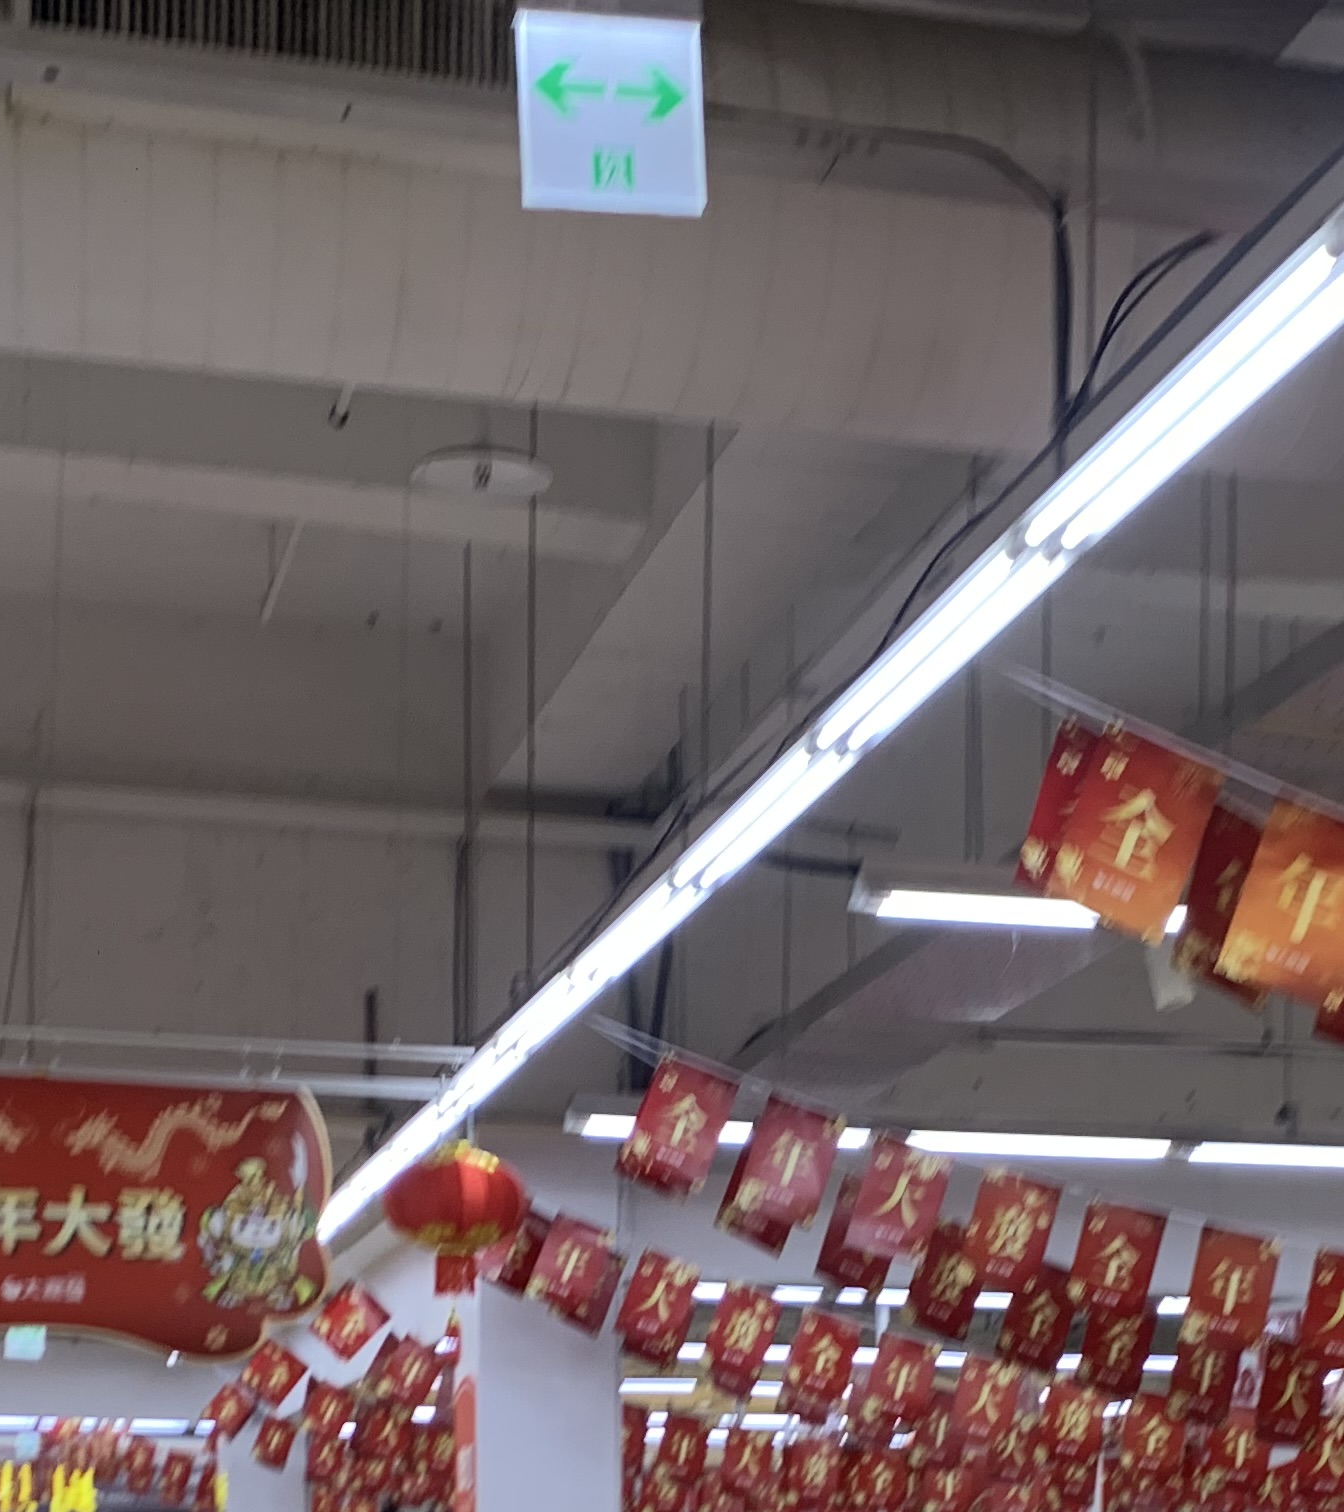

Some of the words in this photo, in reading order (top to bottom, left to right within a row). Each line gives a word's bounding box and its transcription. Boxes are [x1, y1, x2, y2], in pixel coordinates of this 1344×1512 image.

[772, 1128, 815, 1188] 年
[873, 1167, 920, 1229] 大
[1095, 1234, 1142, 1290] 全
[1210, 1257, 1255, 1316] 年
[637, 1277, 680, 1326] 大
